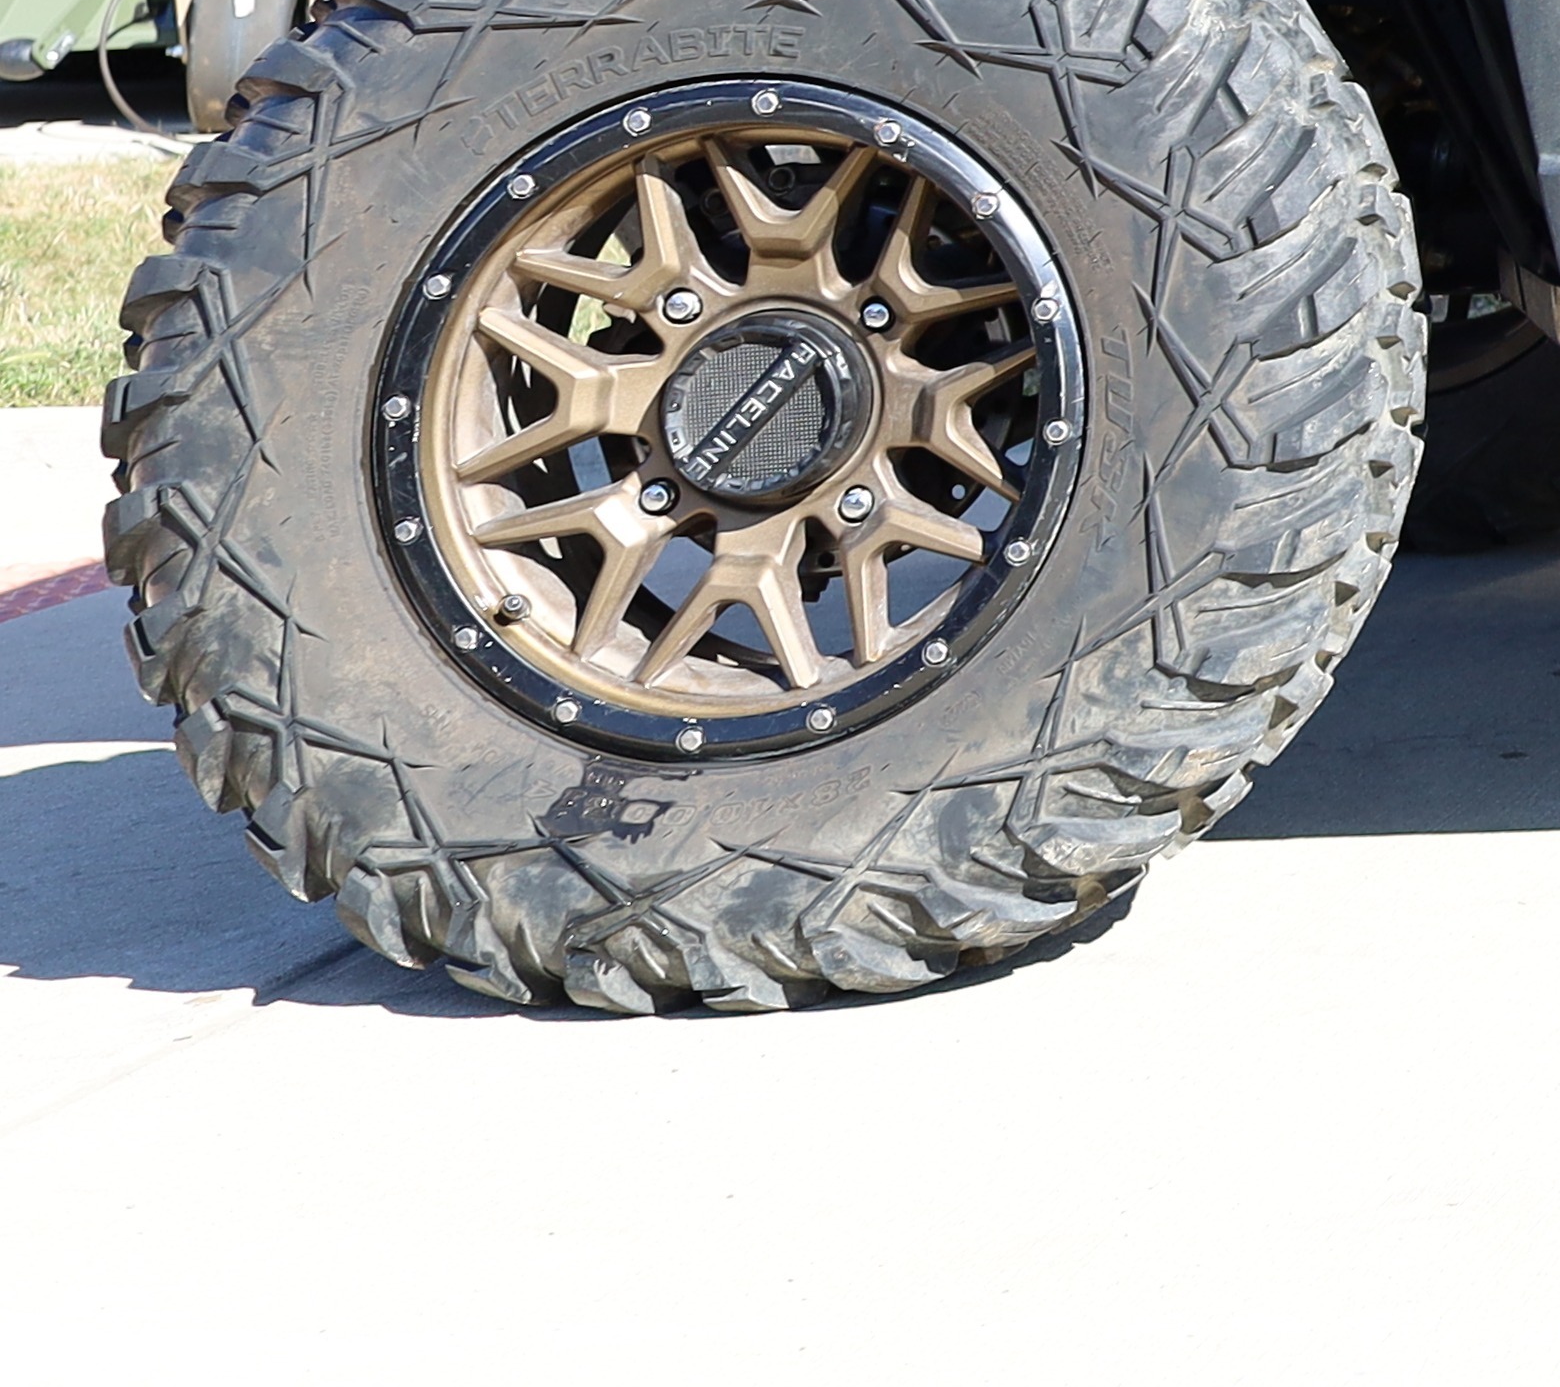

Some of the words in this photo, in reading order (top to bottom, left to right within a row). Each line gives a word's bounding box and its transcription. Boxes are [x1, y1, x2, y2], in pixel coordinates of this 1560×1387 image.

[482, 24, 806, 129] TERRABITE
[684, 342, 818, 481] RACELINE
[1077, 325, 1136, 554] TUSK
